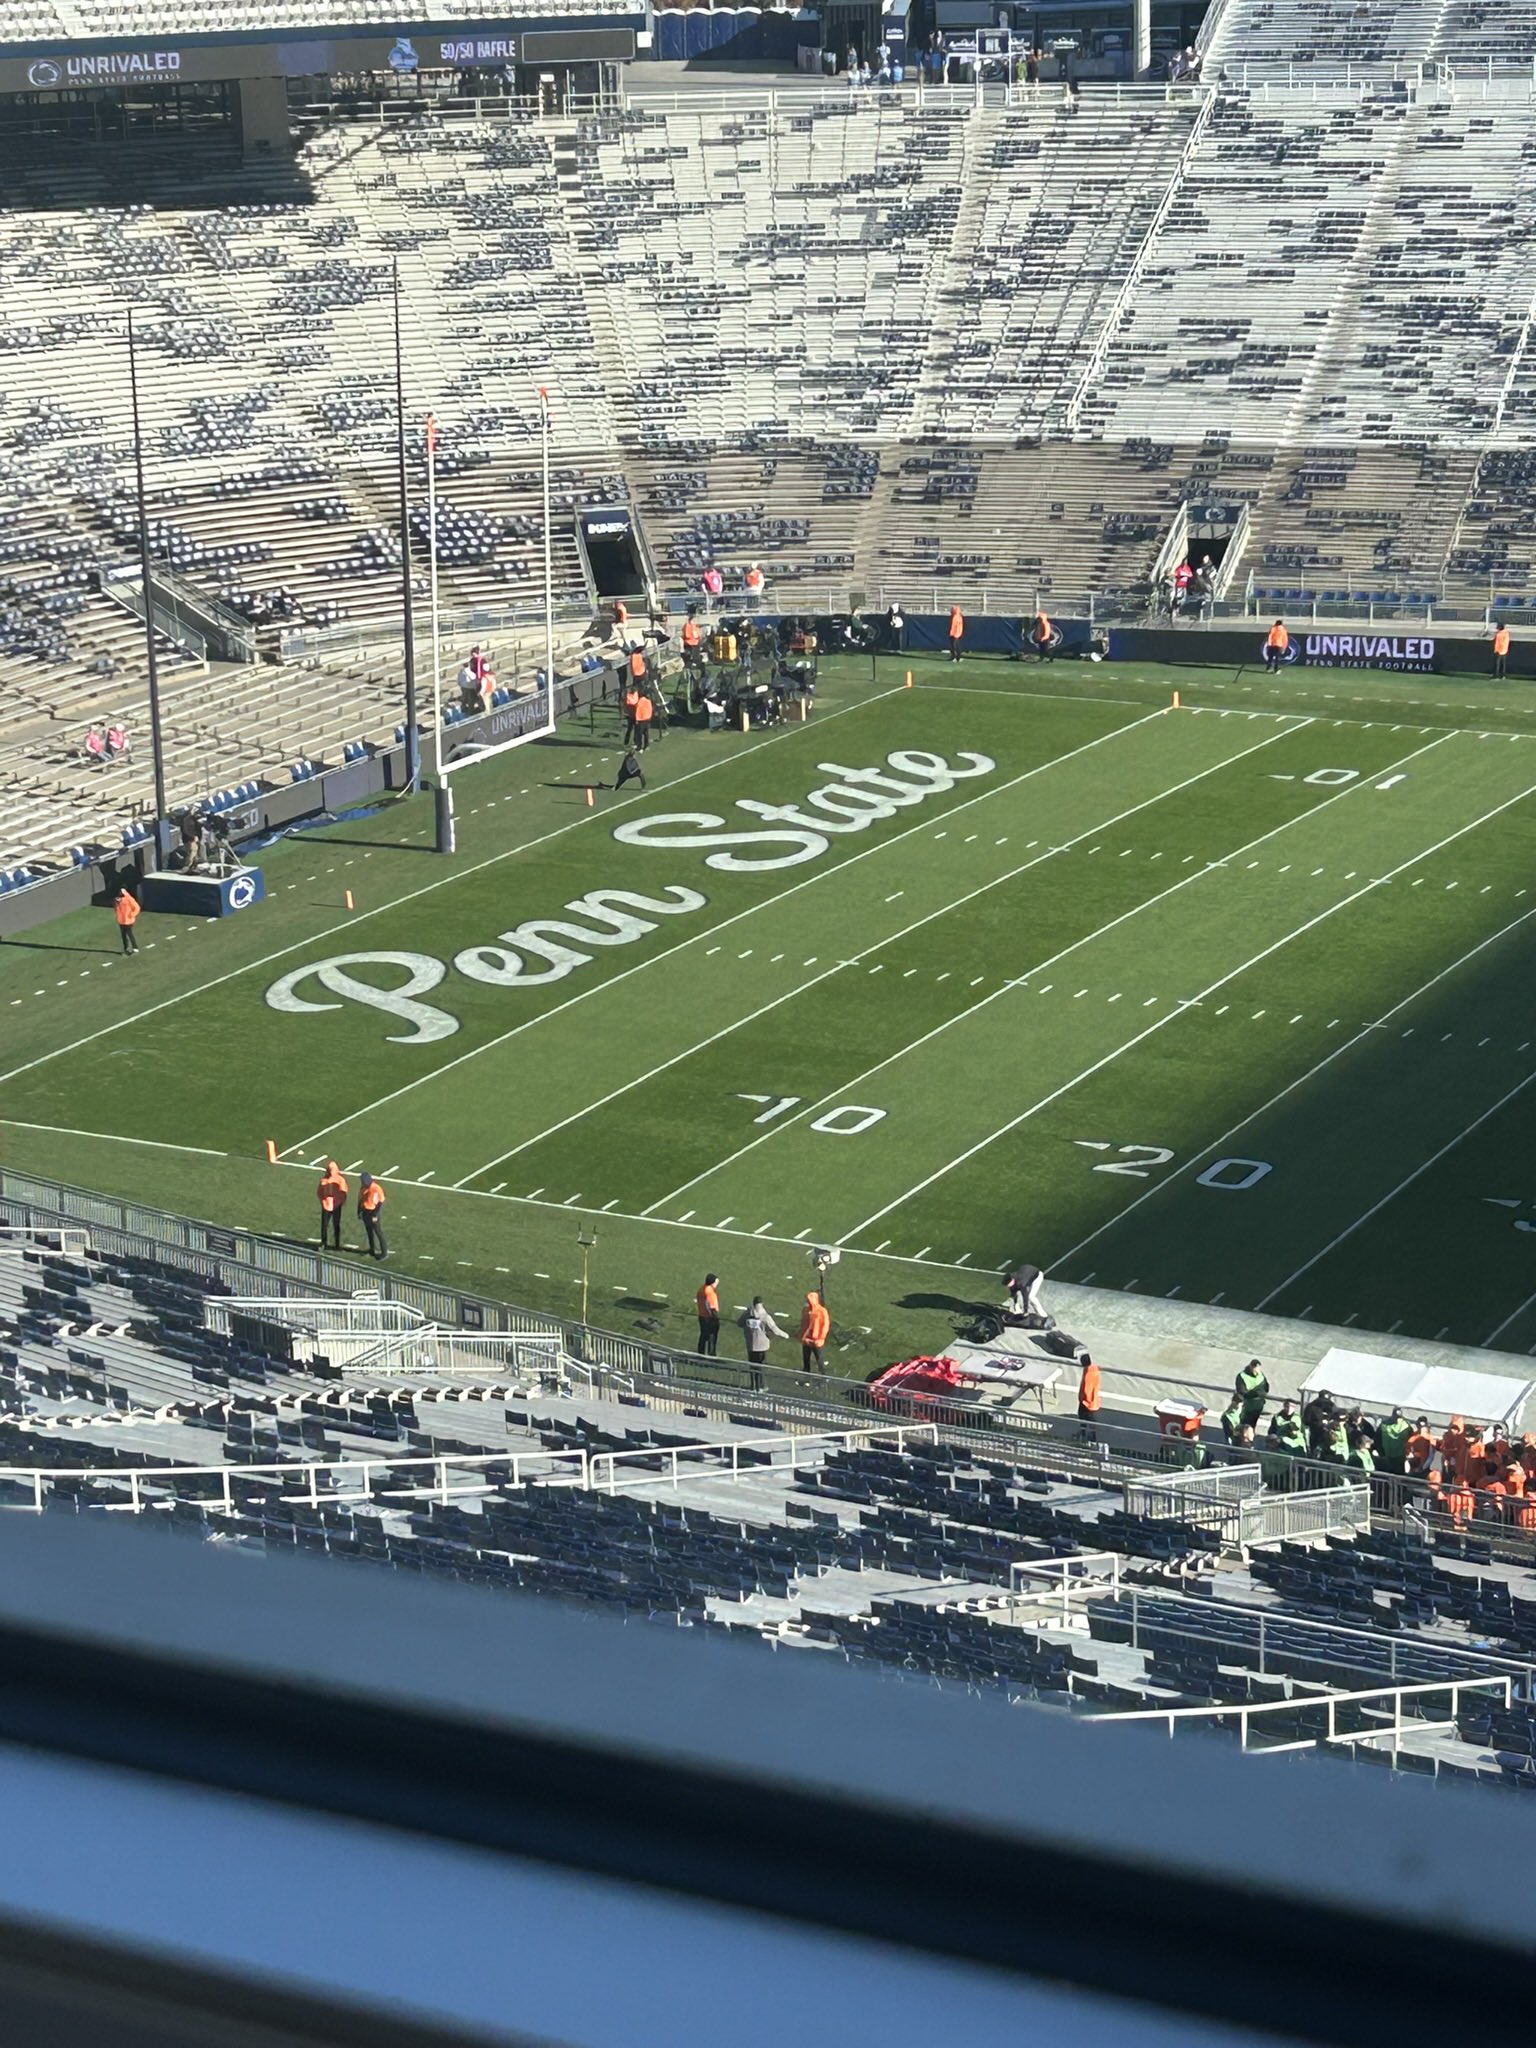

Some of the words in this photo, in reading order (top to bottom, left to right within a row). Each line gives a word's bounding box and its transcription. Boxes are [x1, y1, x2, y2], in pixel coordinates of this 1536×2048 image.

[66, 52, 180, 75] UNRIVALED
[440, 42, 475, 61] 50/50
[1306, 635, 1435, 659] UNRIVALED
[491, 701, 549, 734] UNRIVALE
[265, 884, 707, 1045] Penn
[612, 749, 996, 872] State
